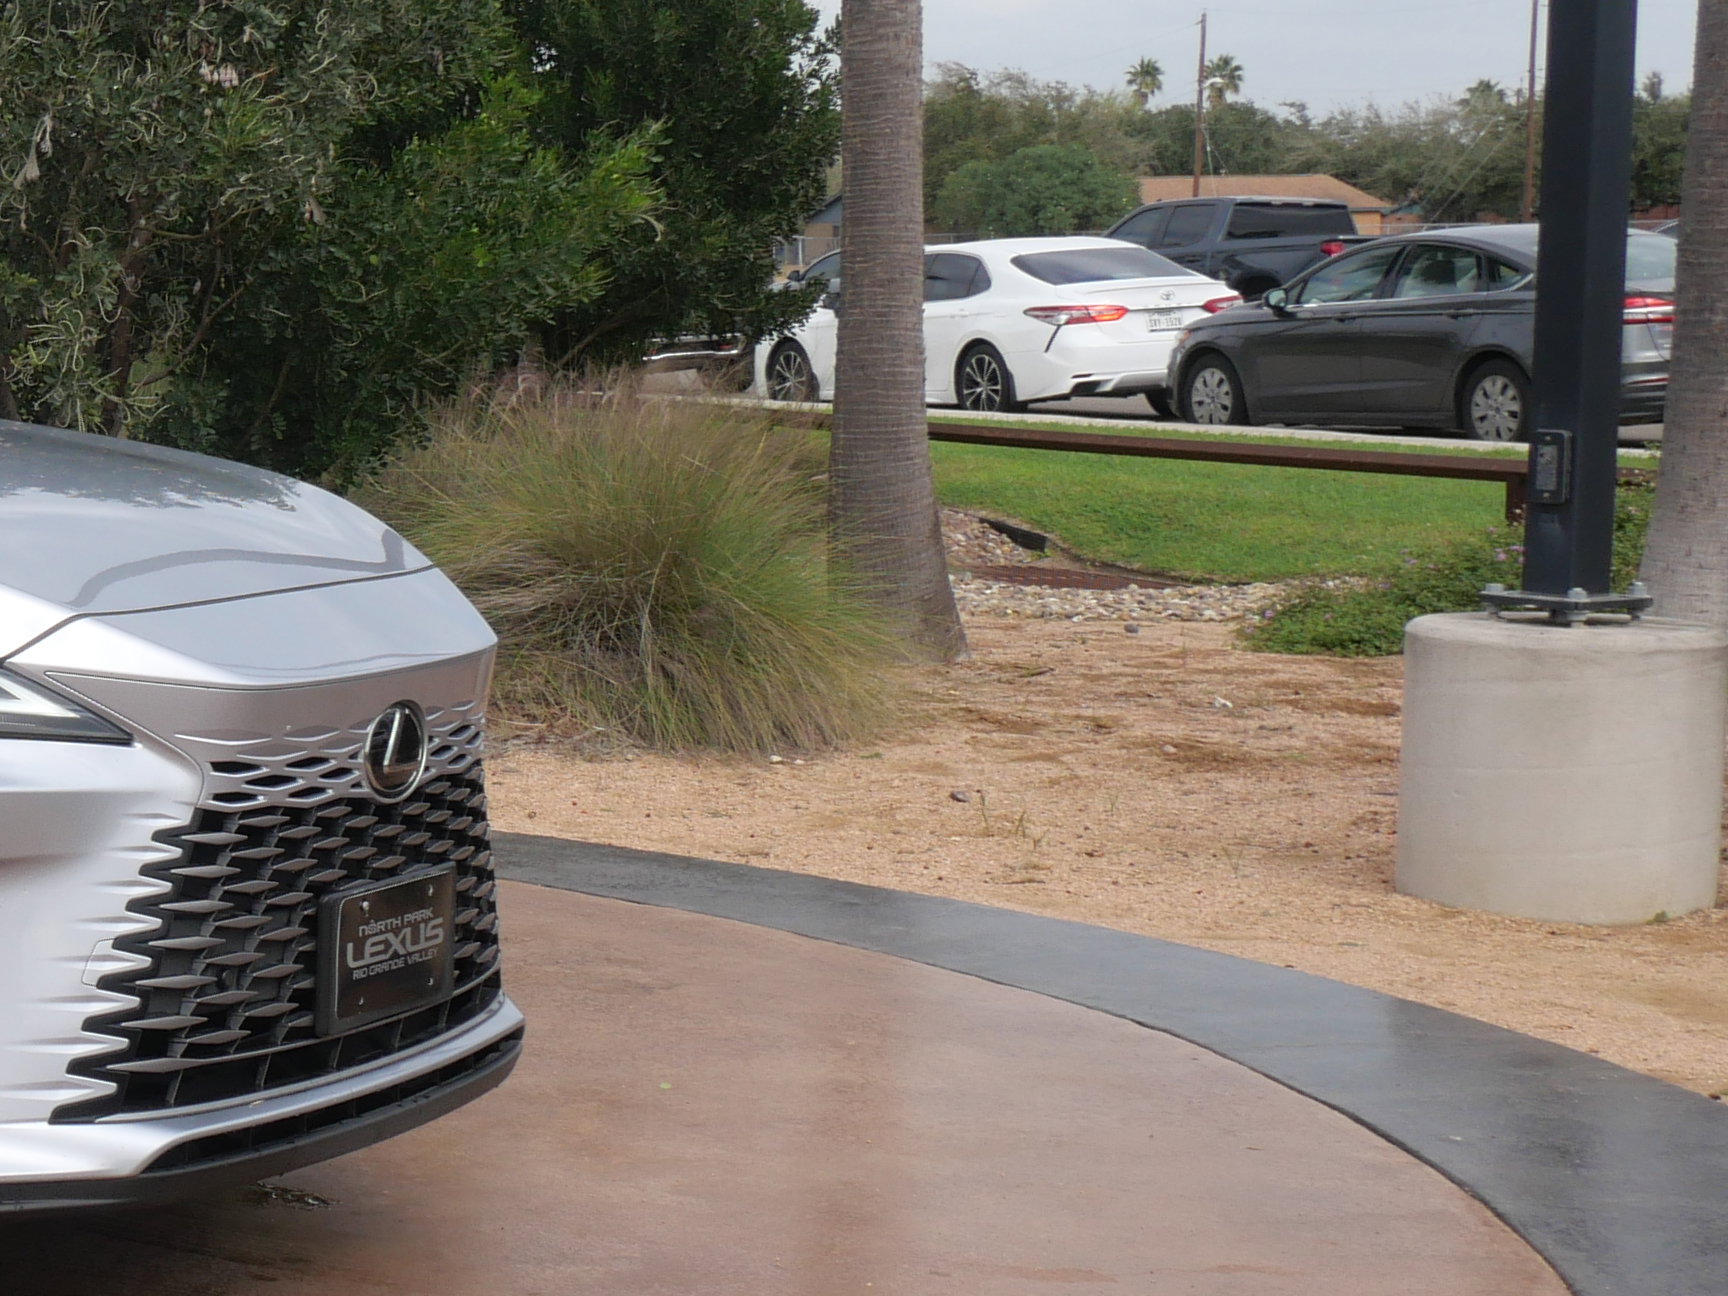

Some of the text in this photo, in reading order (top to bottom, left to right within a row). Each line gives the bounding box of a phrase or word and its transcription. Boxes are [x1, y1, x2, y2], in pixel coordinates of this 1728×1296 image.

[358, 907, 434, 938] NORTH PARK
[346, 917, 444, 969] LEXUS
[352, 947, 439, 981] RIO GRANDE VALLEY
